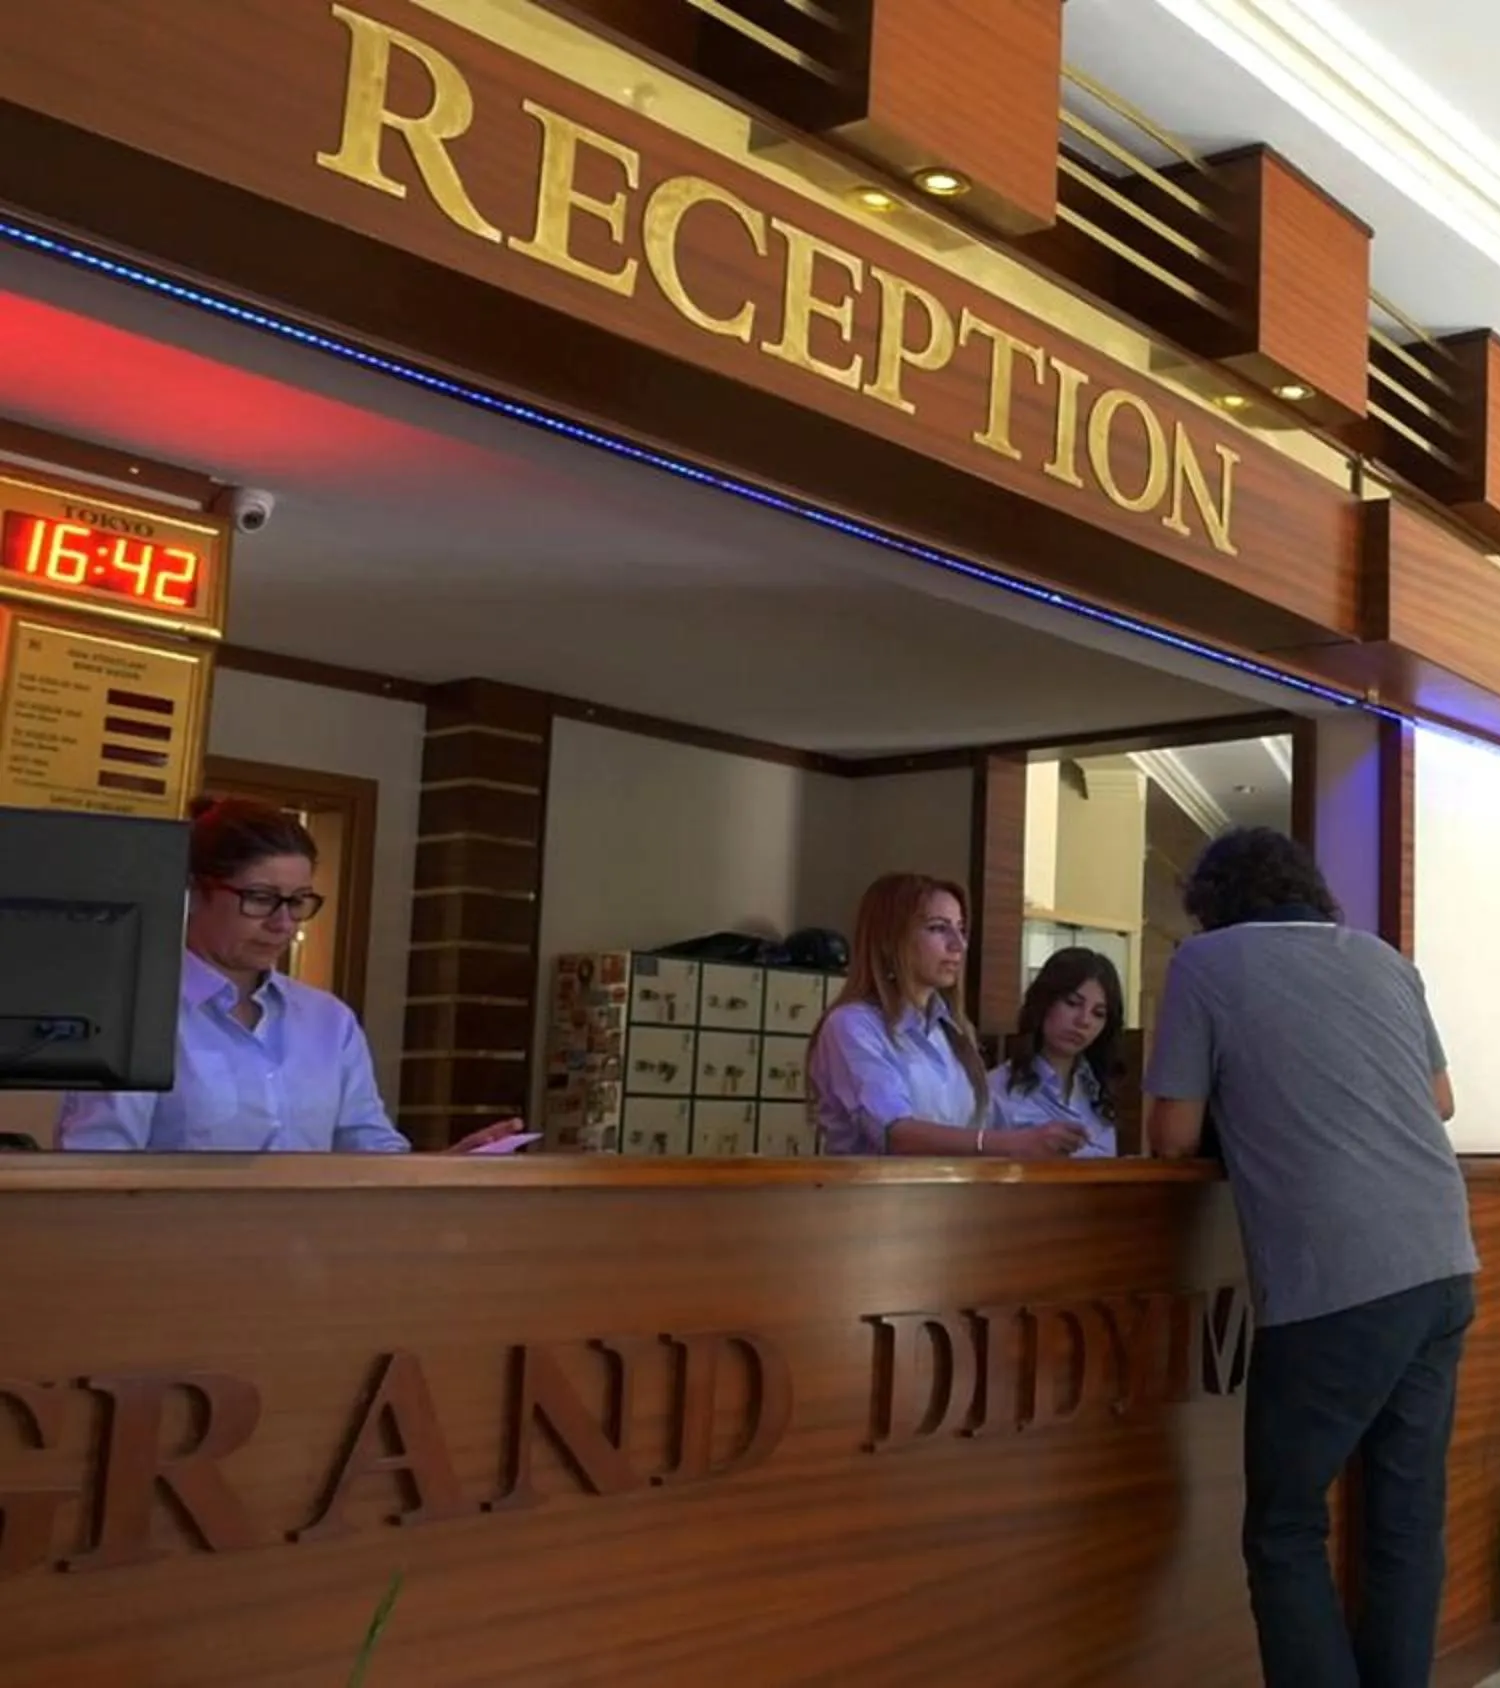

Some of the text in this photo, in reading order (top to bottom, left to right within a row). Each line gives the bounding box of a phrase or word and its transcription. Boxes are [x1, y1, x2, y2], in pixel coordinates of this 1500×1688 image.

[316, 3, 1241, 555] RECEPTION
[26, 520, 197, 606] 16:42
[65, 506, 154, 536] TOKYO
